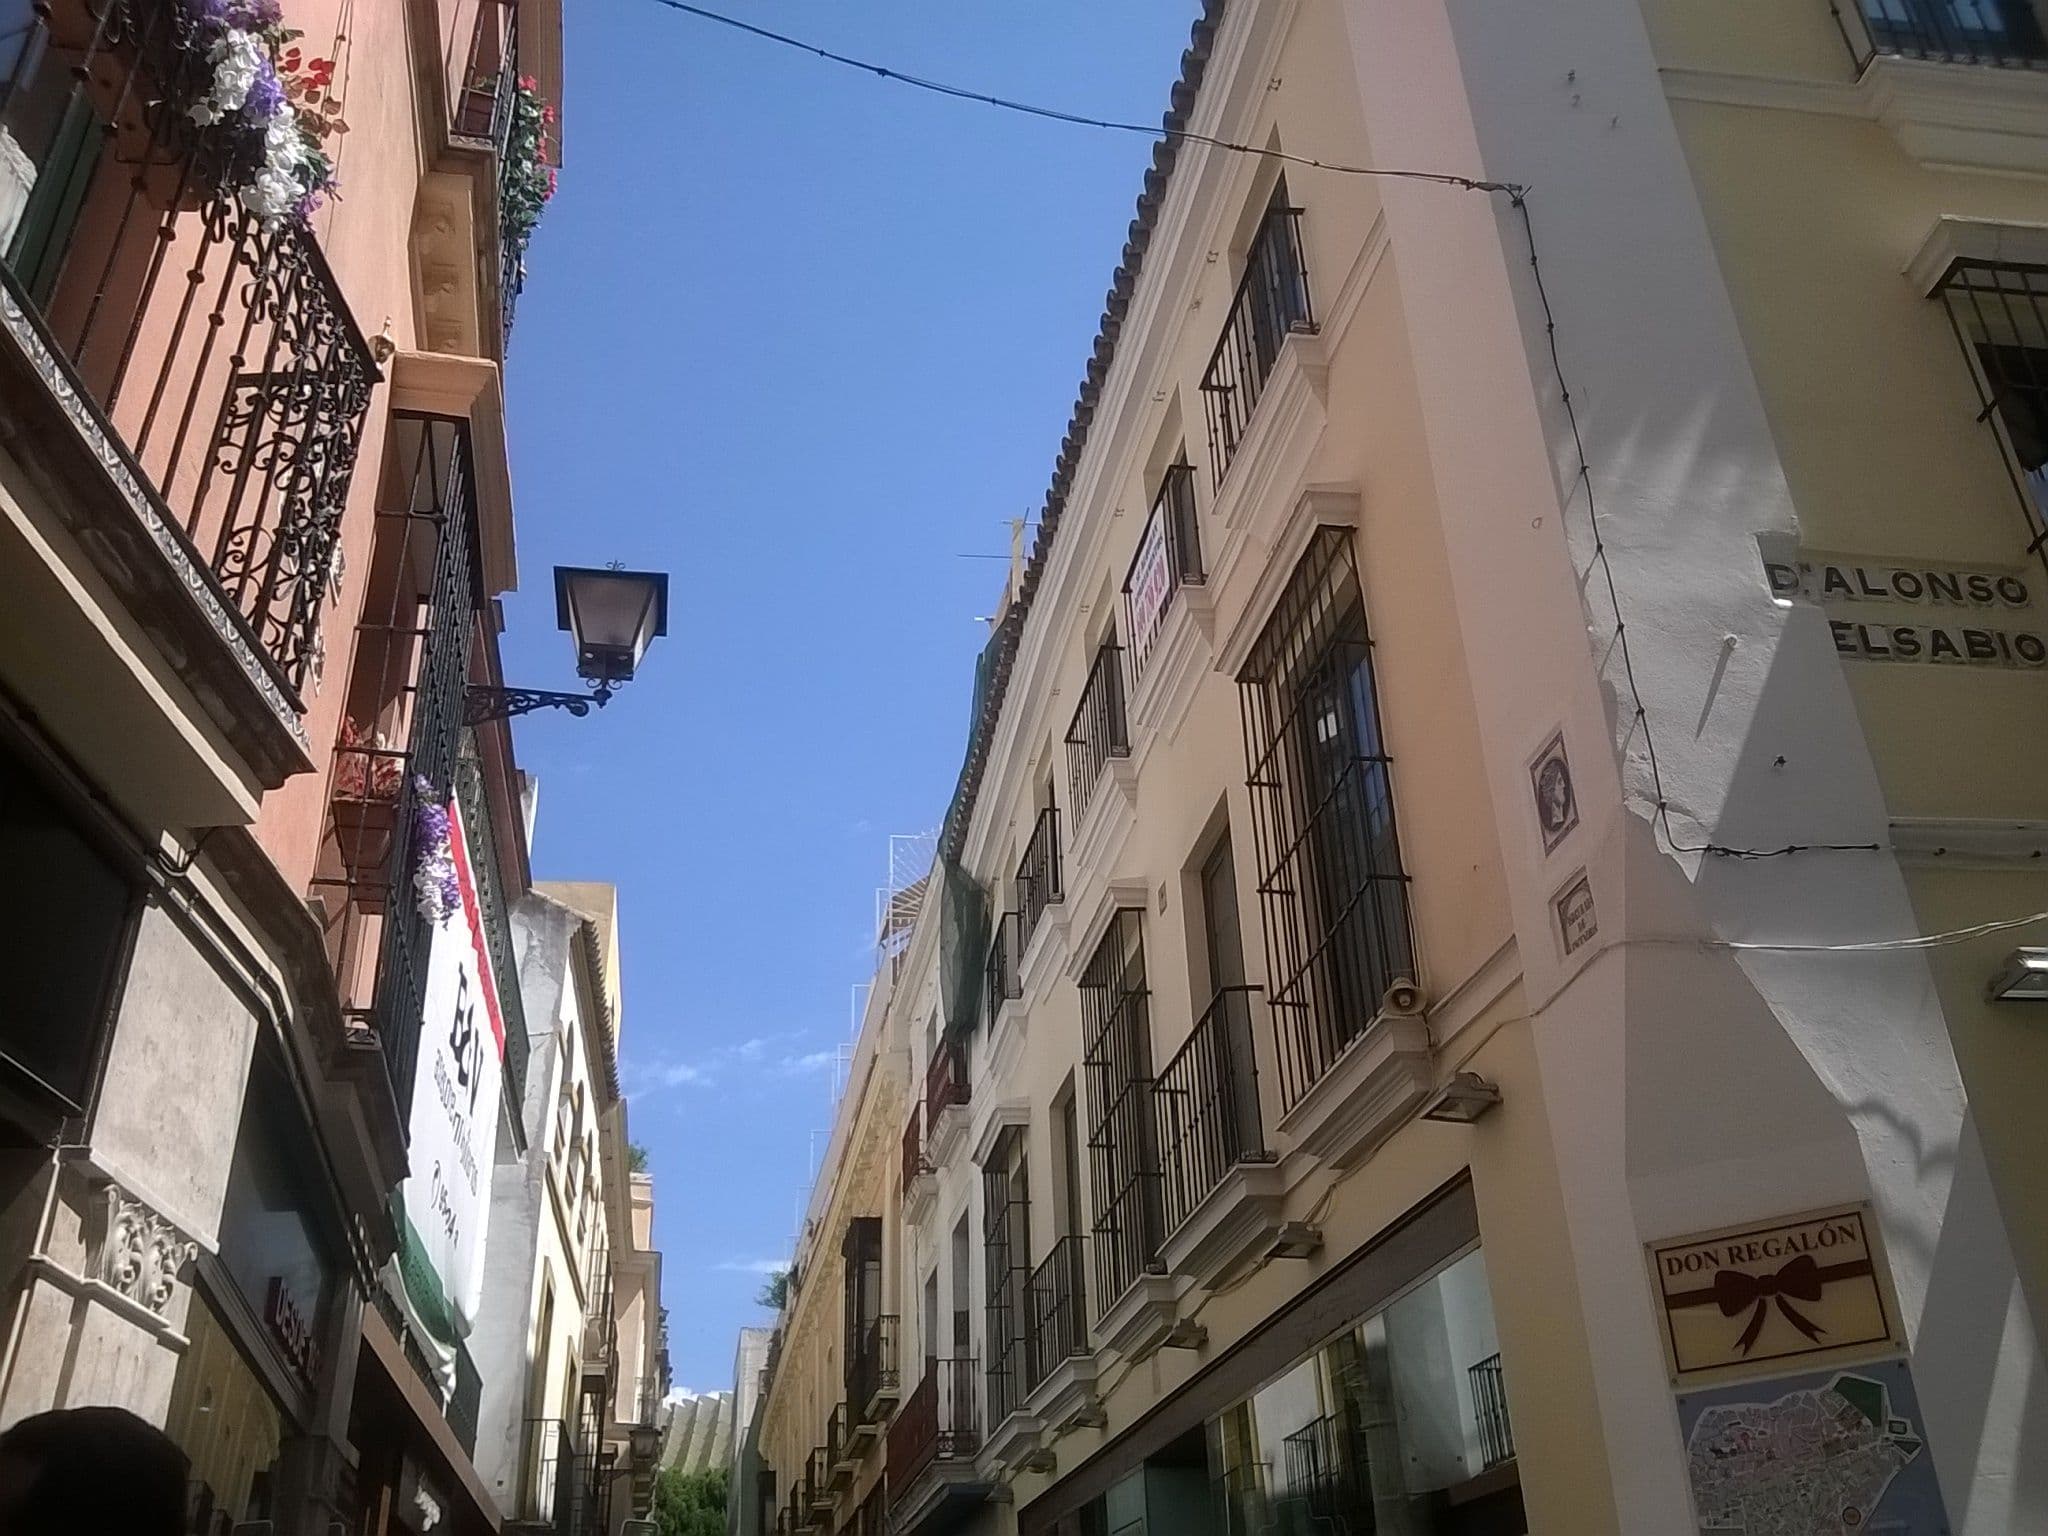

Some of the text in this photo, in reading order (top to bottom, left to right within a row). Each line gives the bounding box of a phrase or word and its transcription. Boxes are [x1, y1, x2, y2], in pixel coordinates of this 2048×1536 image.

[1823, 566, 2028, 604] ALONSO
[1666, 1222, 1857, 1276] DON REGALÓN
